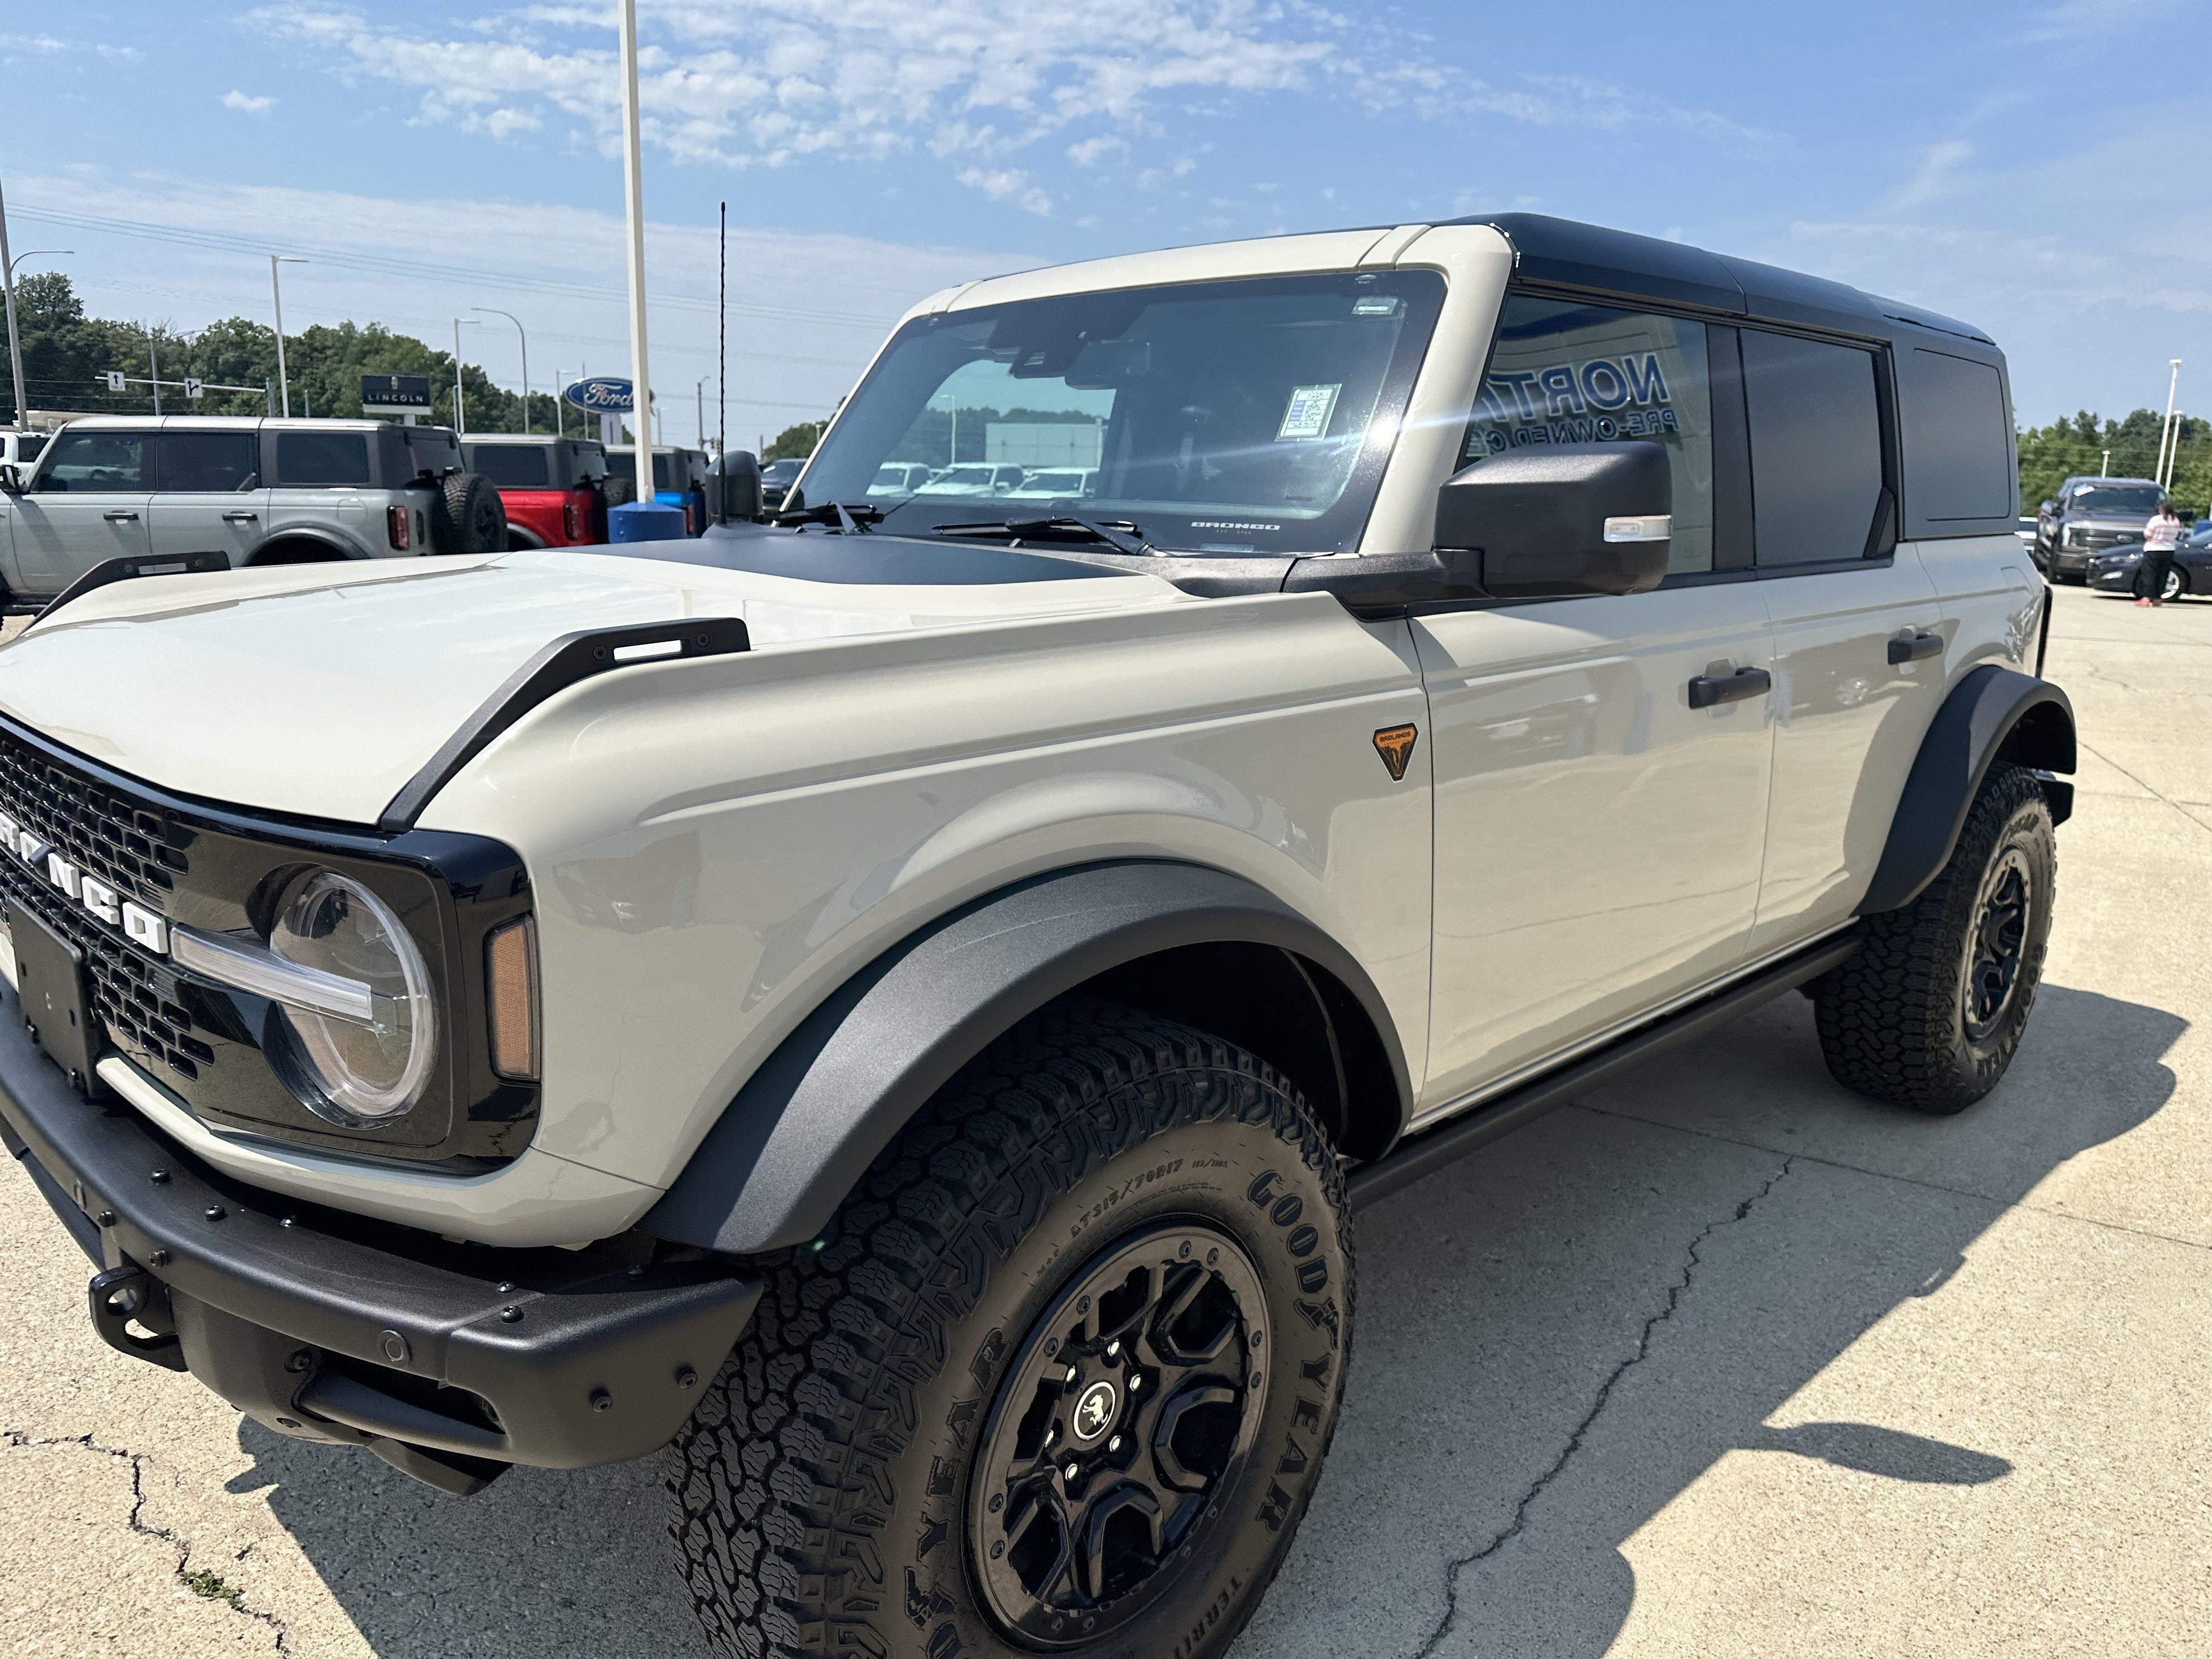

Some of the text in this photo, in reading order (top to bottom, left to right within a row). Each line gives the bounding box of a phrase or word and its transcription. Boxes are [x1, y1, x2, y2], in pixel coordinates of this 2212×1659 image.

[584, 383, 633, 407] Ford
[1191, 522, 1280, 531] BRONCO
[1380, 731, 1411, 742] BADLANDS
